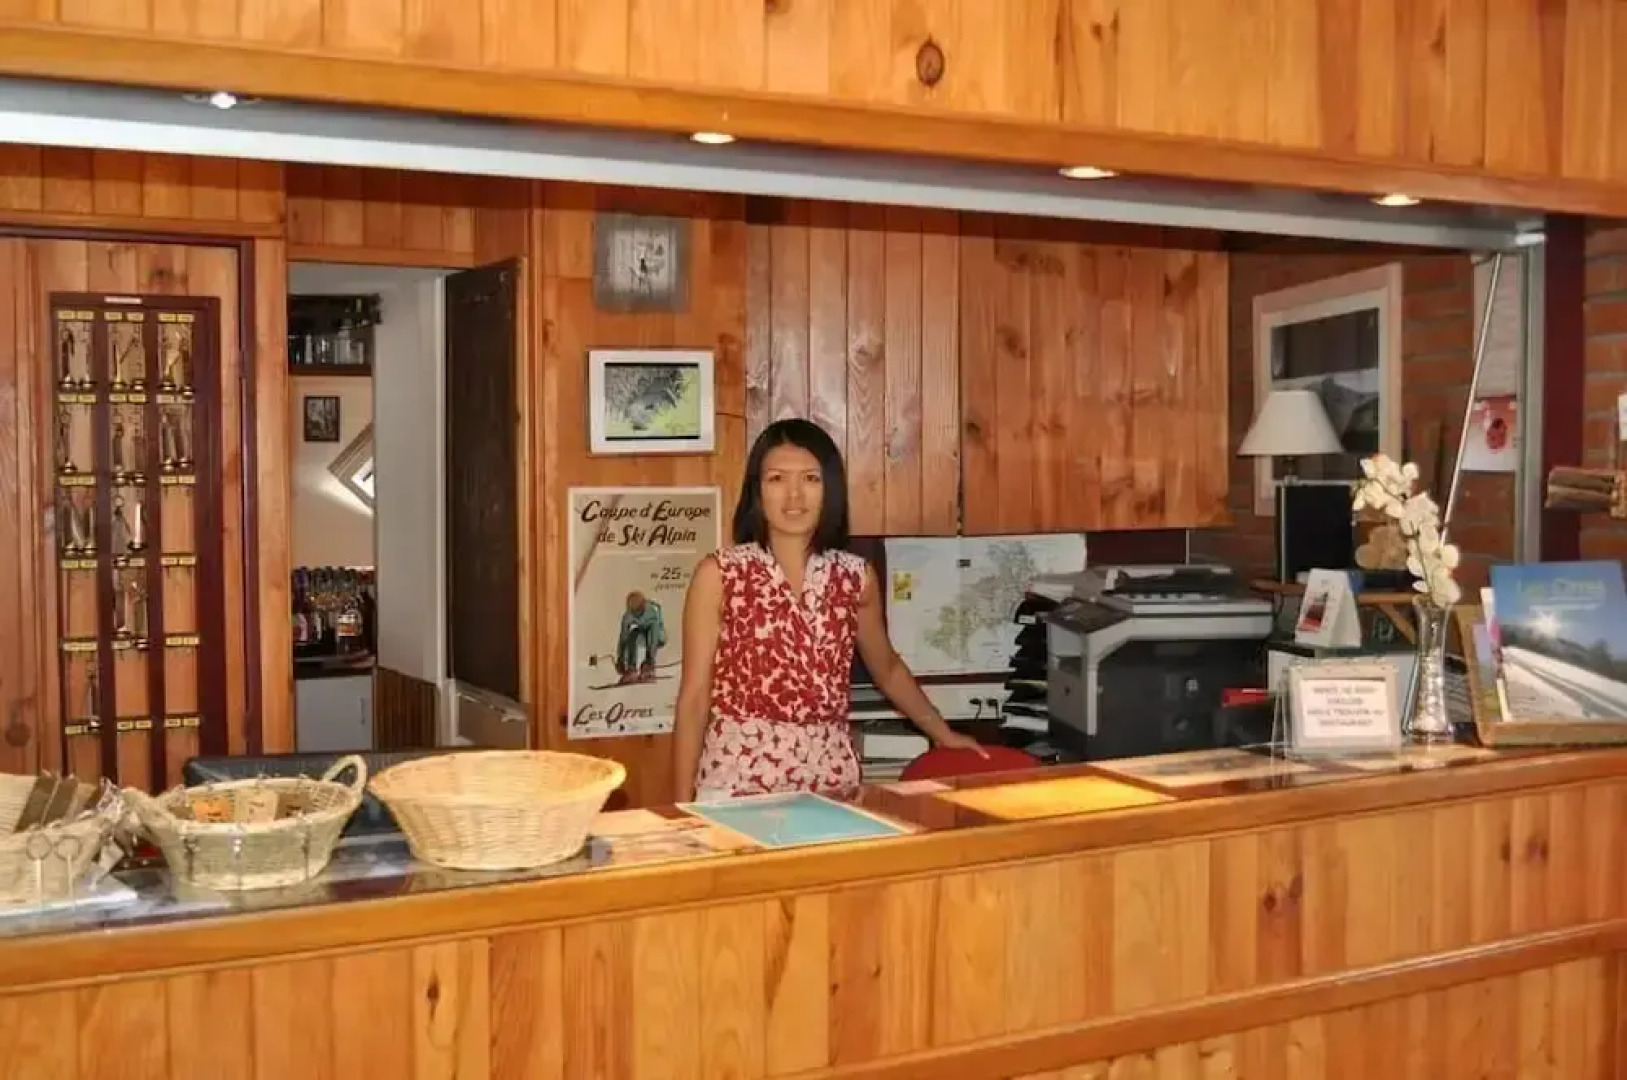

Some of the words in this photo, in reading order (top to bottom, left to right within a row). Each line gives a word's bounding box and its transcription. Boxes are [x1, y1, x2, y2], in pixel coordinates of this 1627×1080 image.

[581, 500, 638, 522] Coupe
[639, 500, 711, 521] d'Europe
[598, 527, 615, 542] de
[618, 524, 645, 546] Ski
[648, 523, 697, 547] Alpin
[660, 566, 682, 580] 25
[572, 703, 603, 727] Les
[605, 702, 654, 724] Orres
